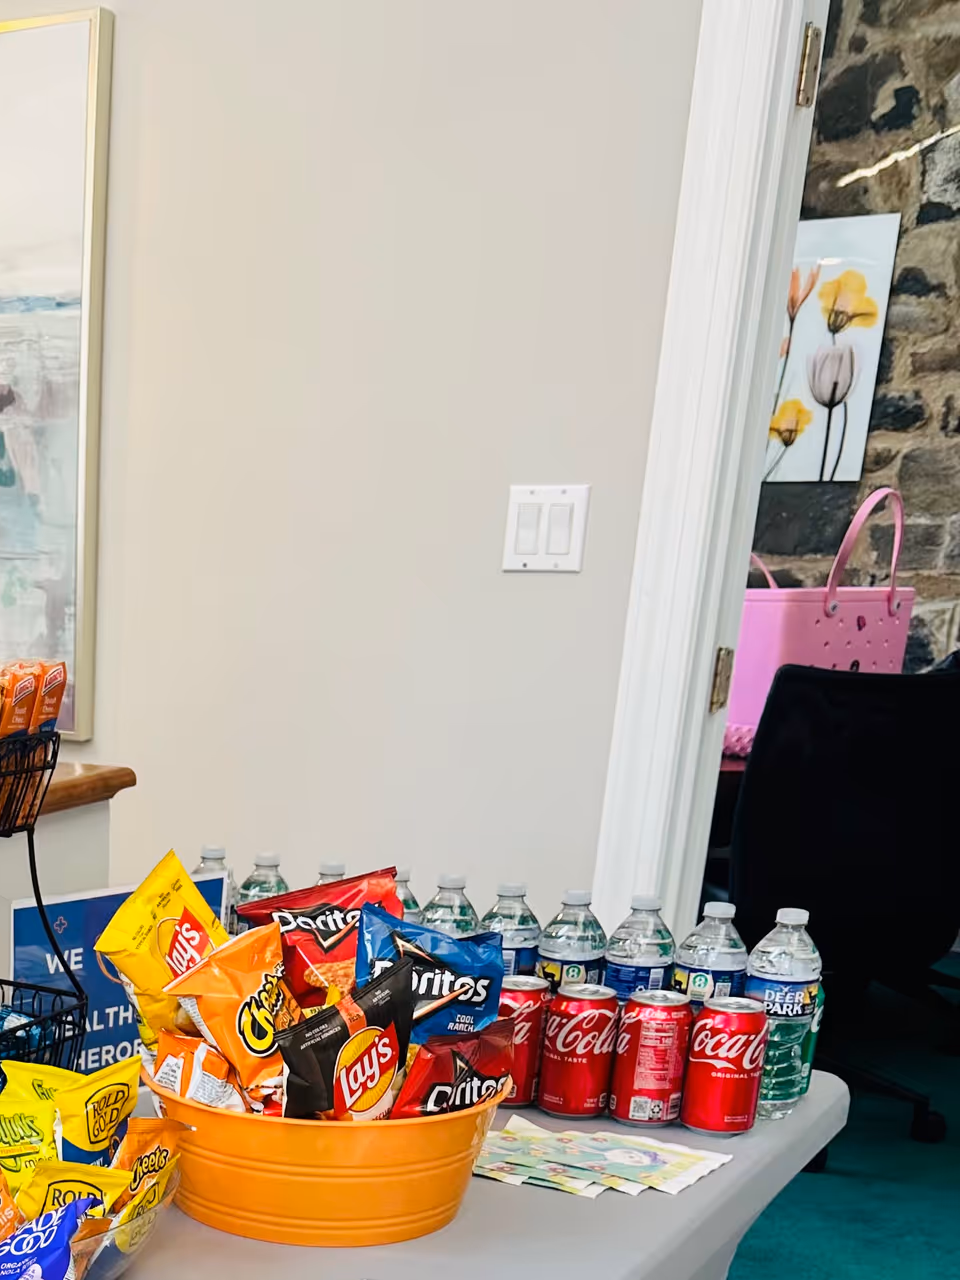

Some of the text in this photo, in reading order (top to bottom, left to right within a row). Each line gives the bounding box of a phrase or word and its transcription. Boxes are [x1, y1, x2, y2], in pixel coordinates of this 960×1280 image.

[272, 907, 363, 934] Dorito
[45, 947, 84, 975] WE
[764, 989, 805, 1004] DEER
[764, 1001, 802, 1016] PARK
[339, 1034, 393, 1110] Lay's
[710, 1071, 748, 1079] ORIGINAL
[92, 1089, 126, 1119] ROLD
